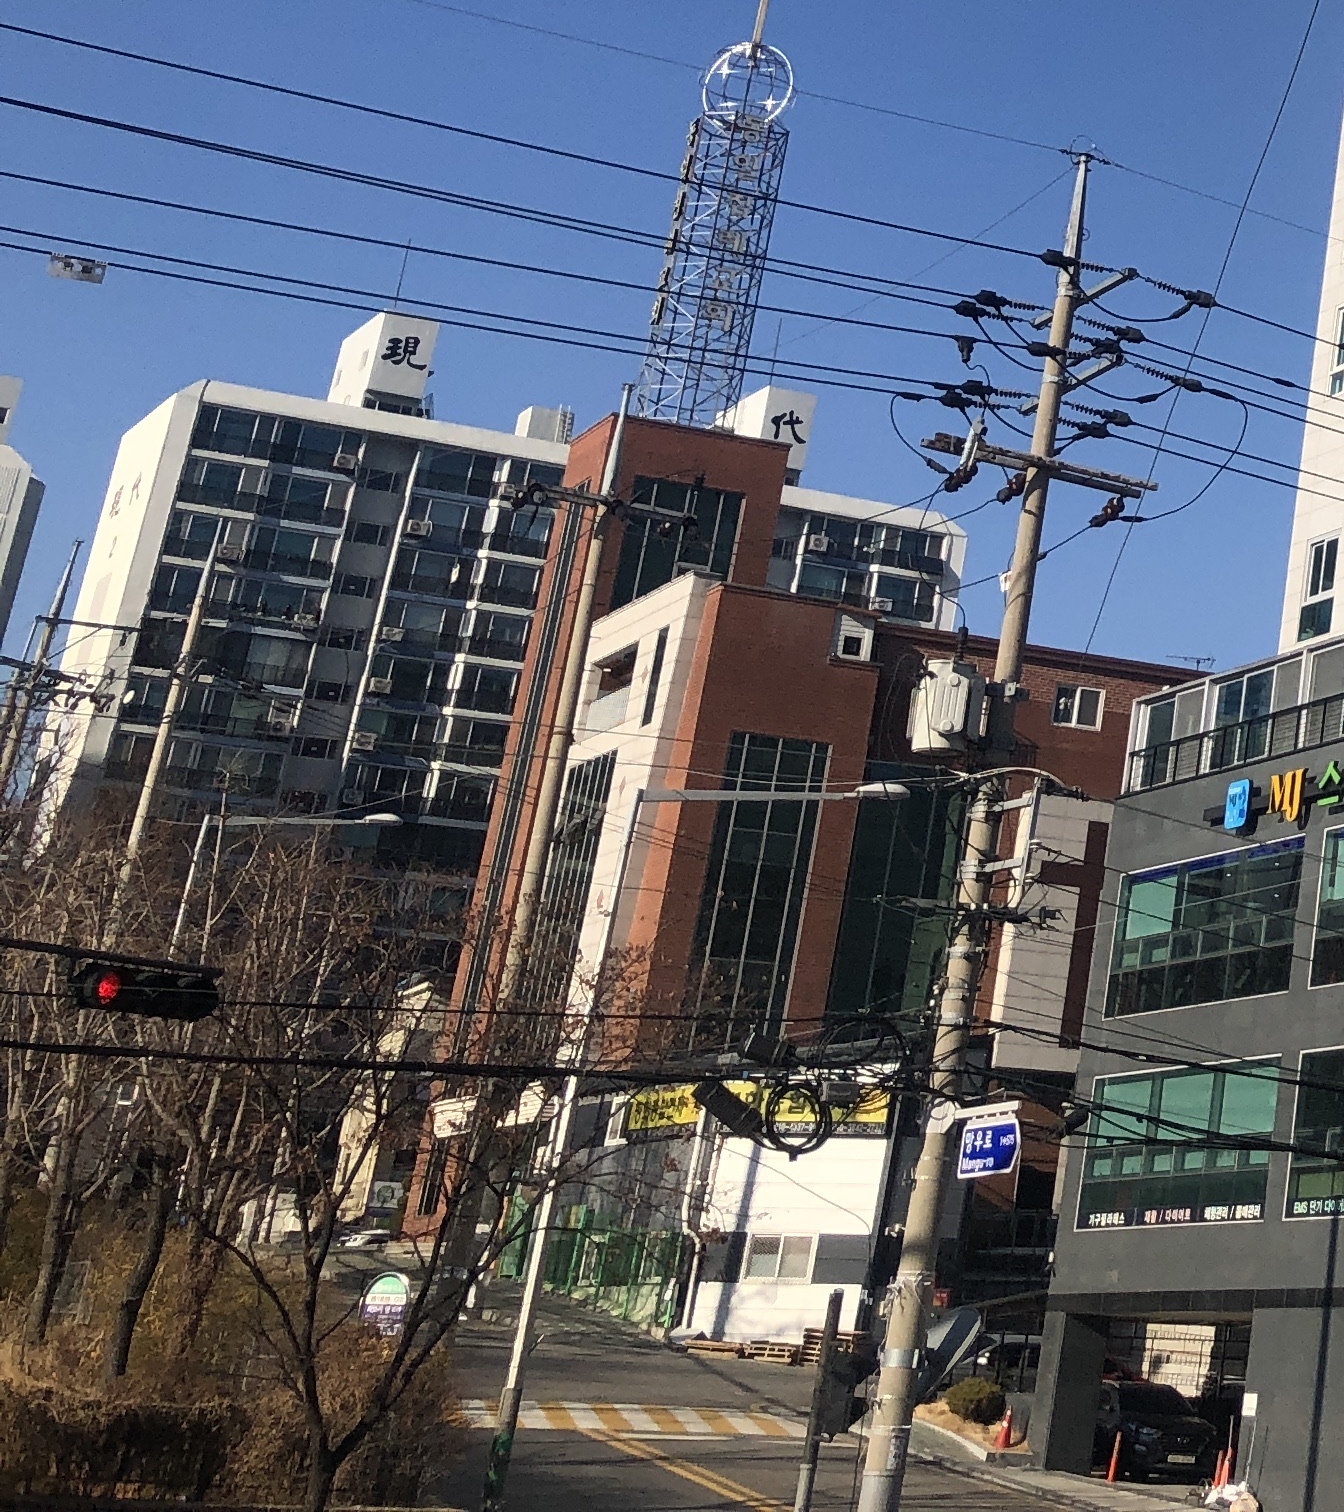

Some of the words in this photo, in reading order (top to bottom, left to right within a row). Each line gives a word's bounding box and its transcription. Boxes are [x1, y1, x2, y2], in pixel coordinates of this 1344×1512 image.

[381, 336, 428, 372] 現
[770, 409, 806, 445] 代
[1266, 767, 1306, 823] MJ
[965, 1130, 993, 1155] 망우로
